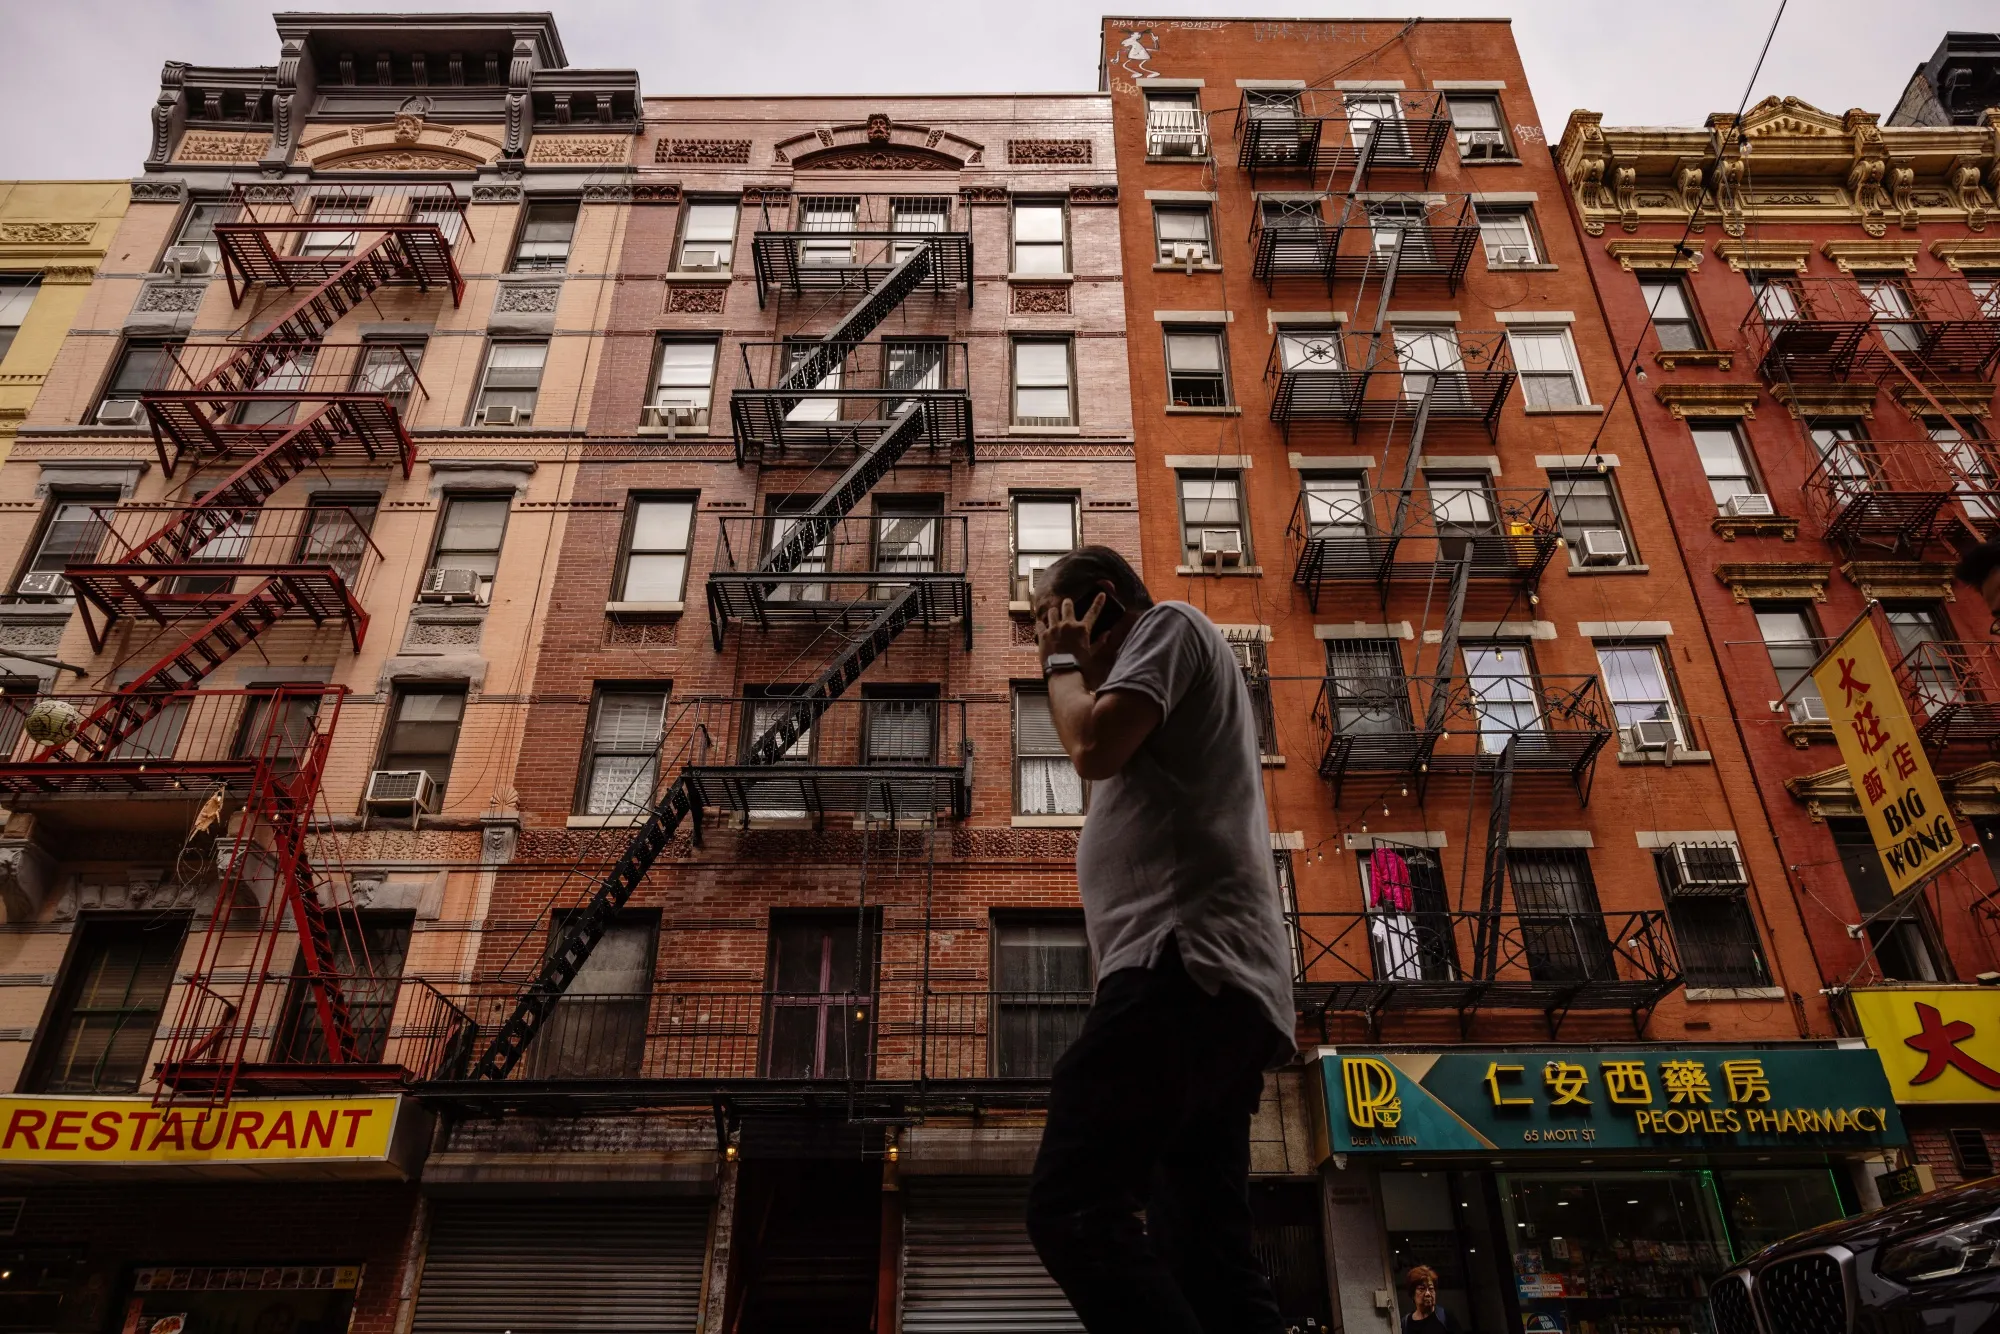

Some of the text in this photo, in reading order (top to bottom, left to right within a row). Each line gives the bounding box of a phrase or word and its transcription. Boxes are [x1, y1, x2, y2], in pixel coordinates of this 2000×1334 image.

[1837, 658, 1890, 756] 大旺
[1882, 787, 1926, 837] BIG
[1885, 815, 1953, 880] WONG
[1903, 1002, 2000, 1091] 大
[1484, 1059, 1771, 1107] 仁安西藥房
[2, 1109, 372, 1151] RESTAURANT
[1351, 1135, 1417, 1145] DEPT. WITHIN
[1523, 1128, 1596, 1142] 65 MOTT ST
[1635, 1106, 1887, 1134] PEOPLES PHARMACY
